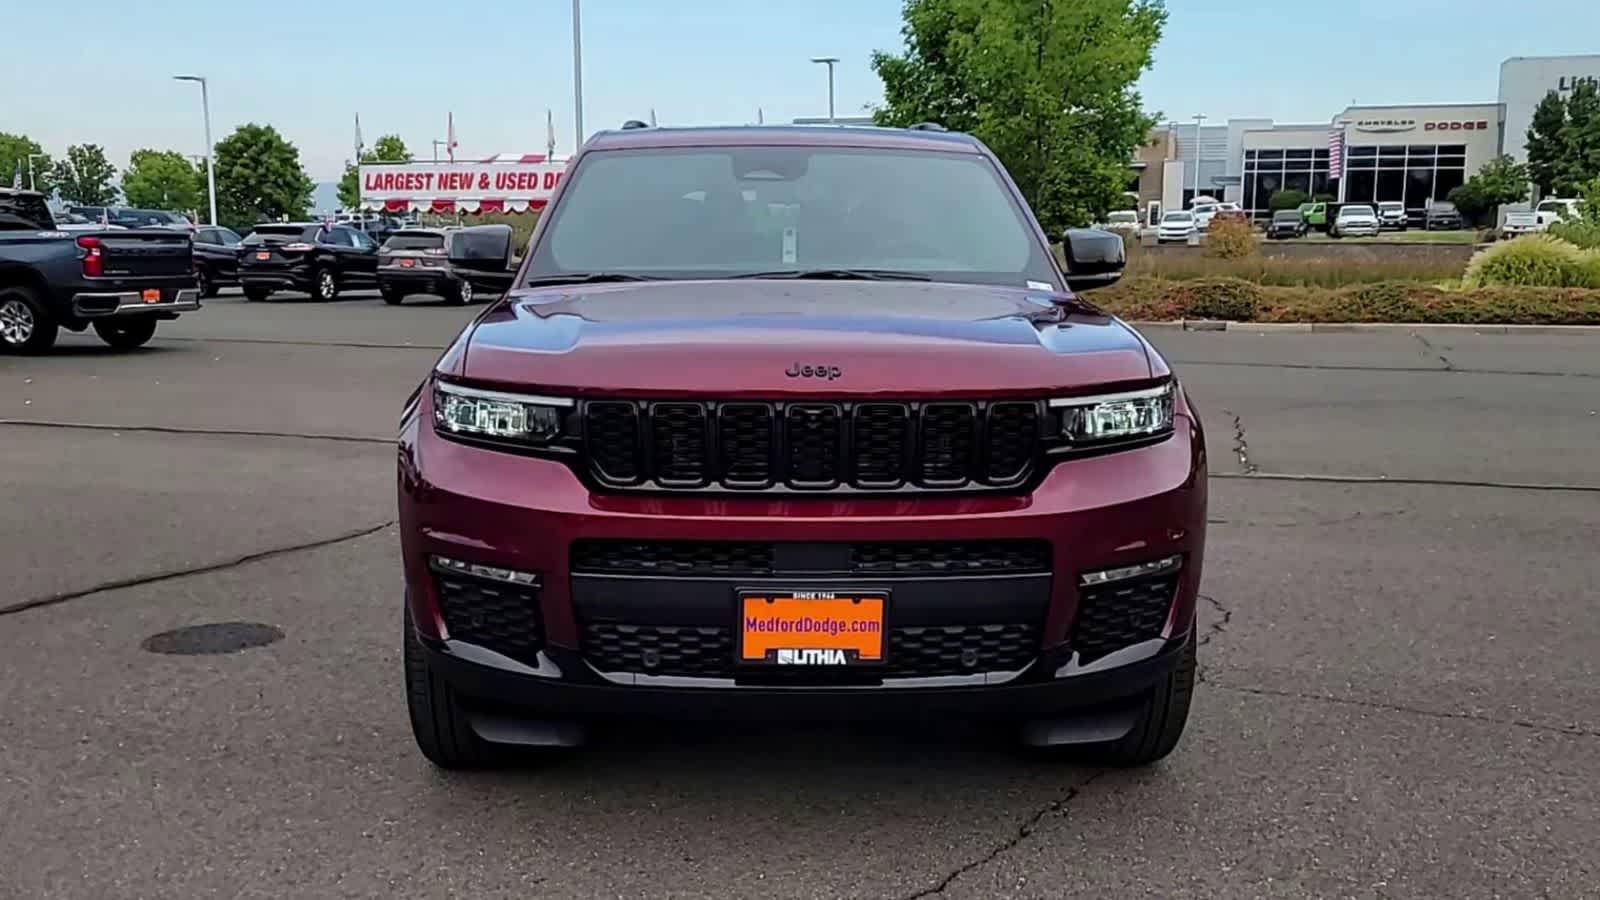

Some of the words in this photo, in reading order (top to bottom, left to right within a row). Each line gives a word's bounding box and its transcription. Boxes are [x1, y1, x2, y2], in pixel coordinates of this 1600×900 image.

[1558, 75, 1600, 91] Lith
[1424, 120, 1488, 131] DODGE
[365, 173, 434, 191] LARGEST
[437, 173, 473, 190] NEW
[478, 173, 490, 190] &
[496, 172, 538, 190] USED
[785, 362, 842, 381] Jeep
[792, 592, 816, 600] SINCE
[745, 616, 881, 637] MedfordDodge.com
[793, 649, 847, 665] LITHIA
